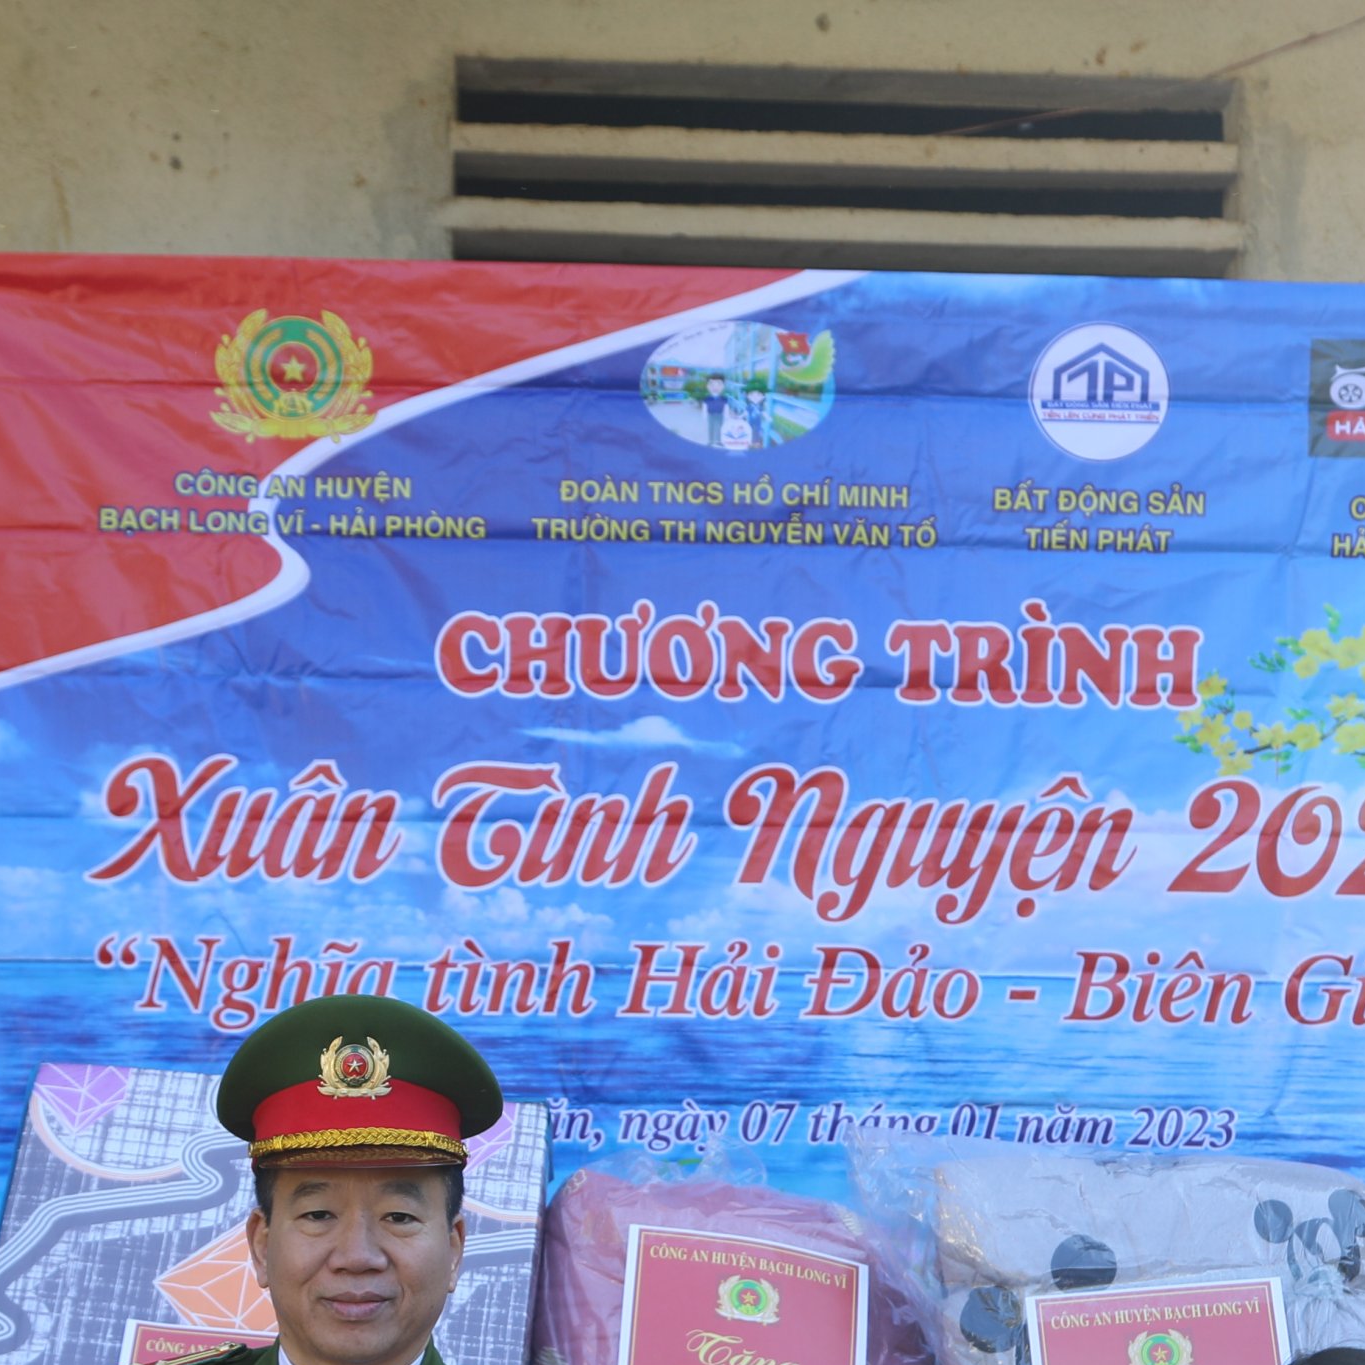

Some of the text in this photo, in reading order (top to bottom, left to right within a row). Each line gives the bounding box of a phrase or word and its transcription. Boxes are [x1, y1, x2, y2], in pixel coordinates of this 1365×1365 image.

[174, 468, 412, 504] CÔNG AN HUYỆN
[559, 474, 910, 509] ĐOÀN TNCS HỒ CHÍ MINH
[993, 482, 1207, 520] BẤT ĐỘNG SẢN
[99, 504, 487, 540] BẠCH LONG VĨ HẢI PHÒNG
[531, 512, 939, 549] TRƯỜNG TH NGUYỄN VĂN TỐ
[1026, 517, 1176, 555] TIẾN PHÁT
[438, 599, 1202, 709] CHƯƠNG TRÌNH
[89, 754, 402, 886] Xuân
[434, 761, 696, 890] Tình
[724, 765, 1137, 923] Nguyện
[425, 938, 596, 1015] tình
[619, 940, 780, 1018] Hải
[805, 942, 982, 1021] Đảo
[1064, 950, 1253, 1025] Biên
[620, 1100, 727, 1151] ngày
[742, 1102, 796, 1142] 07
[951, 1103, 1001, 1140] 01
[1017, 1104, 1113, 1145] năm
[1128, 1106, 1235, 1149] 2023
[649, 1243, 848, 1289] CÔNG AN HUYỆN BẠCH LONG VĨ
[1051, 1297, 1261, 1330] CÔNG AN HUYỆN BẠCH LONG VĨ
[145, 1337, 185, 1355] CÔNG
